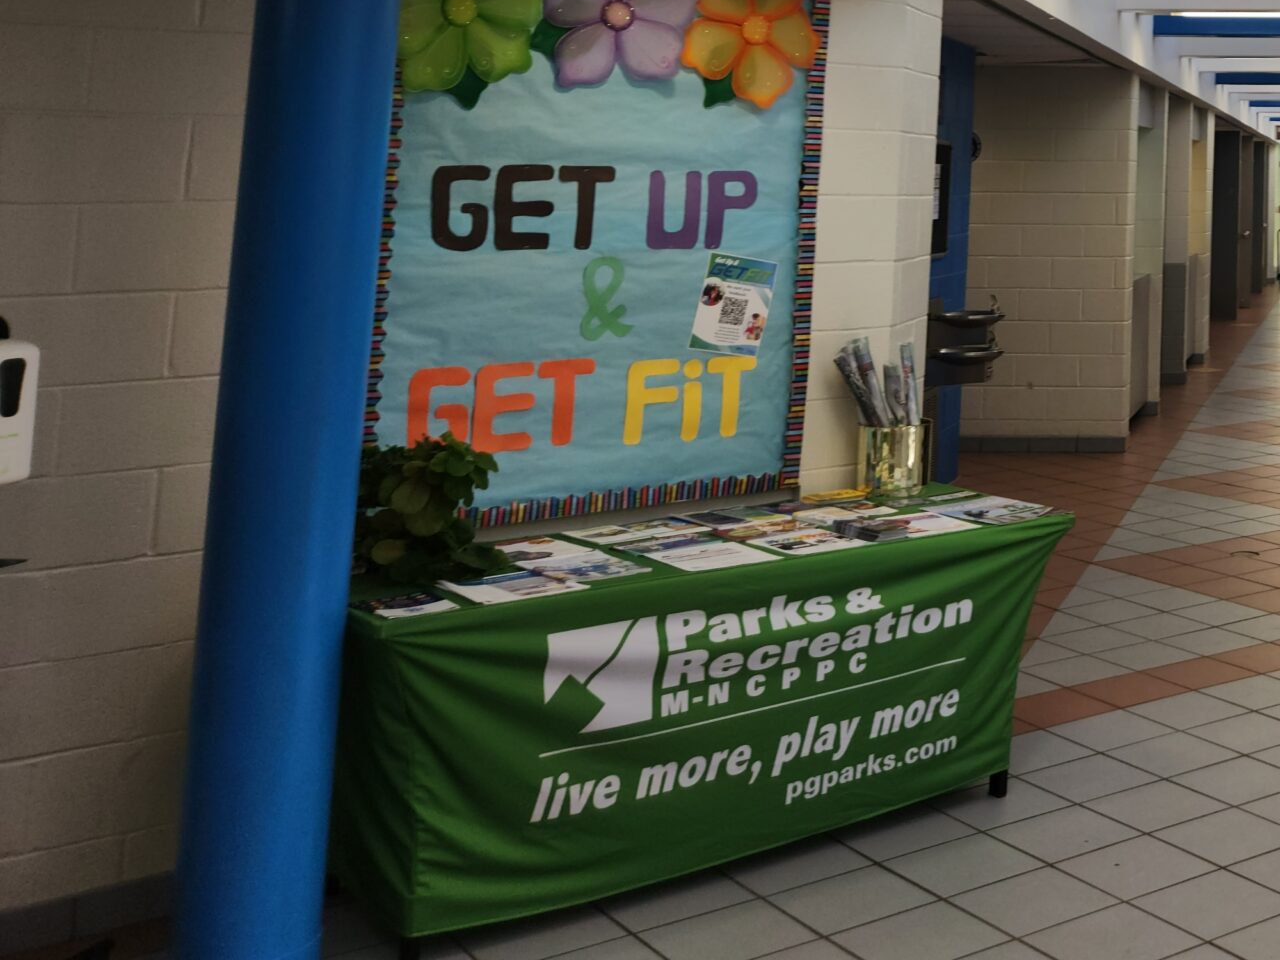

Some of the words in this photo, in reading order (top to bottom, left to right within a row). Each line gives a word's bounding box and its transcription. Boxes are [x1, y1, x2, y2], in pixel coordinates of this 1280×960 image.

[431, 164, 616, 252] GET
[646, 170, 758, 250] UP
[580, 256, 635, 341] &
[407, 358, 597, 453] GET
[662, 598, 973, 689] Recreation
[665, 595, 836, 652] Parks
[845, 587, 885, 615] &
[530, 772, 621, 824] live
[635, 743, 762, 801] more,
[771, 716, 853, 777] play
[869, 689, 960, 739] more
[785, 734, 957, 805] pgparks.com
